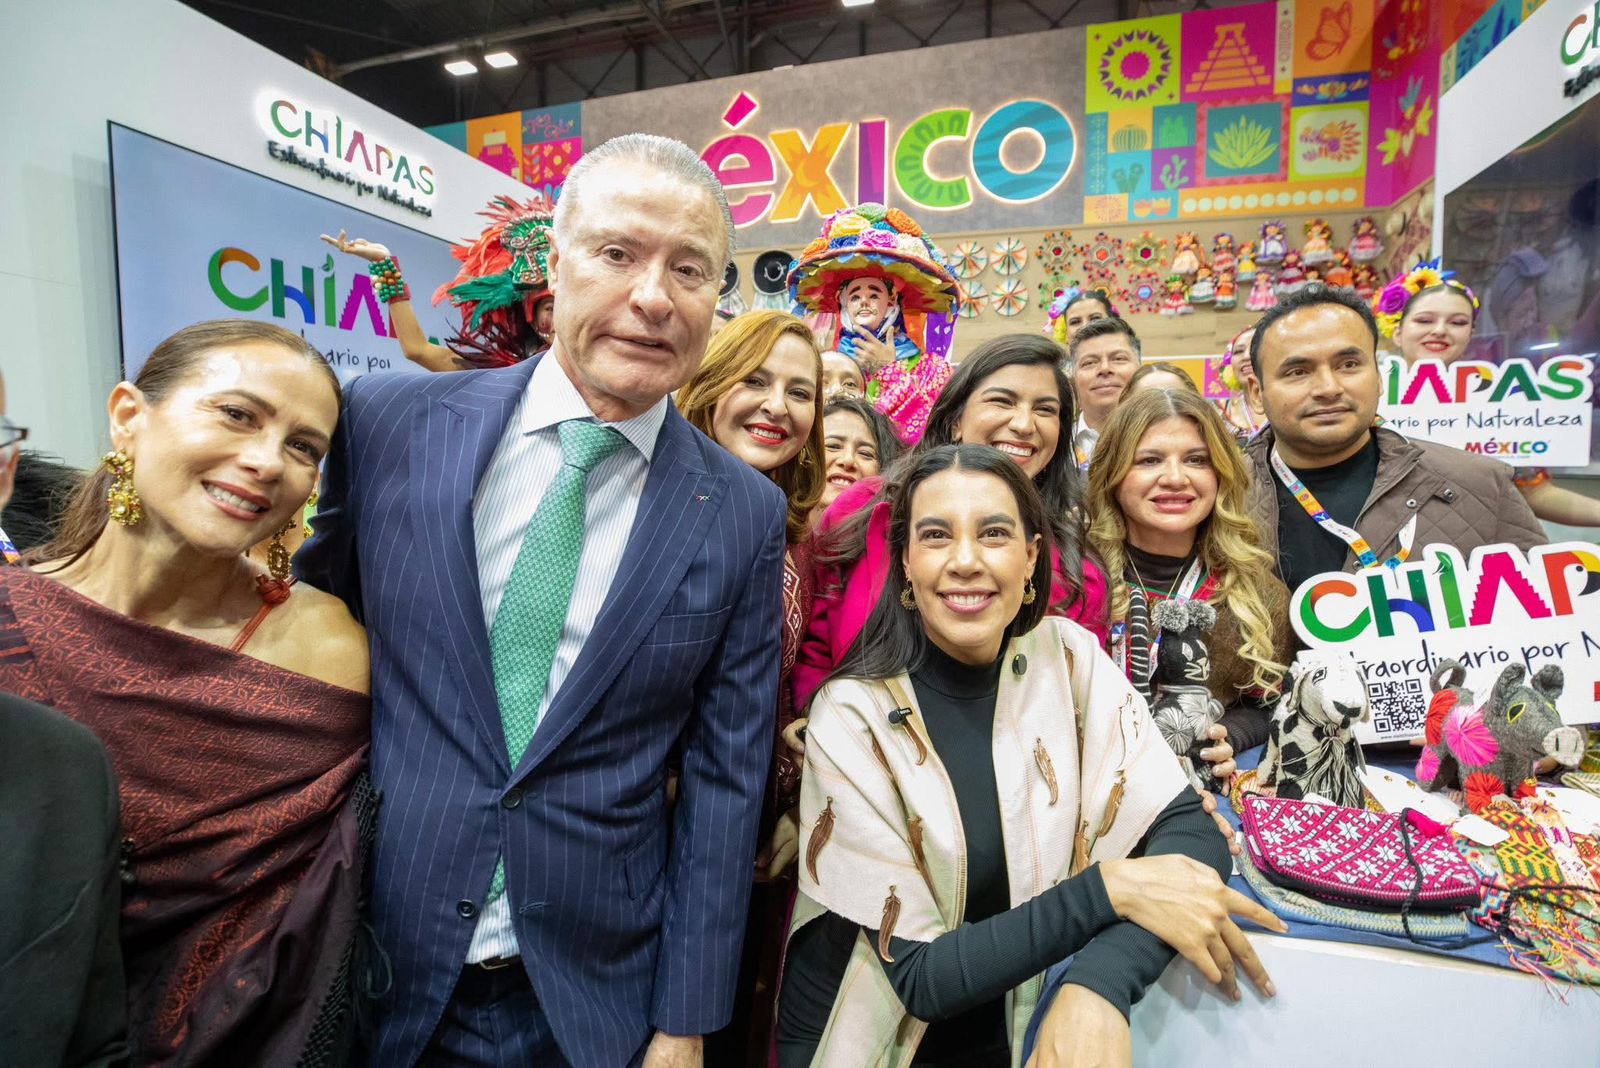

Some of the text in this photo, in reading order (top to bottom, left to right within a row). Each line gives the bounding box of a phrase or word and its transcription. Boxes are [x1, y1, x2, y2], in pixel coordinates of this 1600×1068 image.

[270, 100, 434, 195] CHIAPAS
[699, 91, 1077, 229] éXICO
[1387, 359, 1585, 406] IAPAS
[1427, 417, 1459, 436] por
[1466, 408, 1583, 429] Naturaleza
[1299, 551, 1600, 643] CHIAP
[1521, 641, 1570, 676] por
